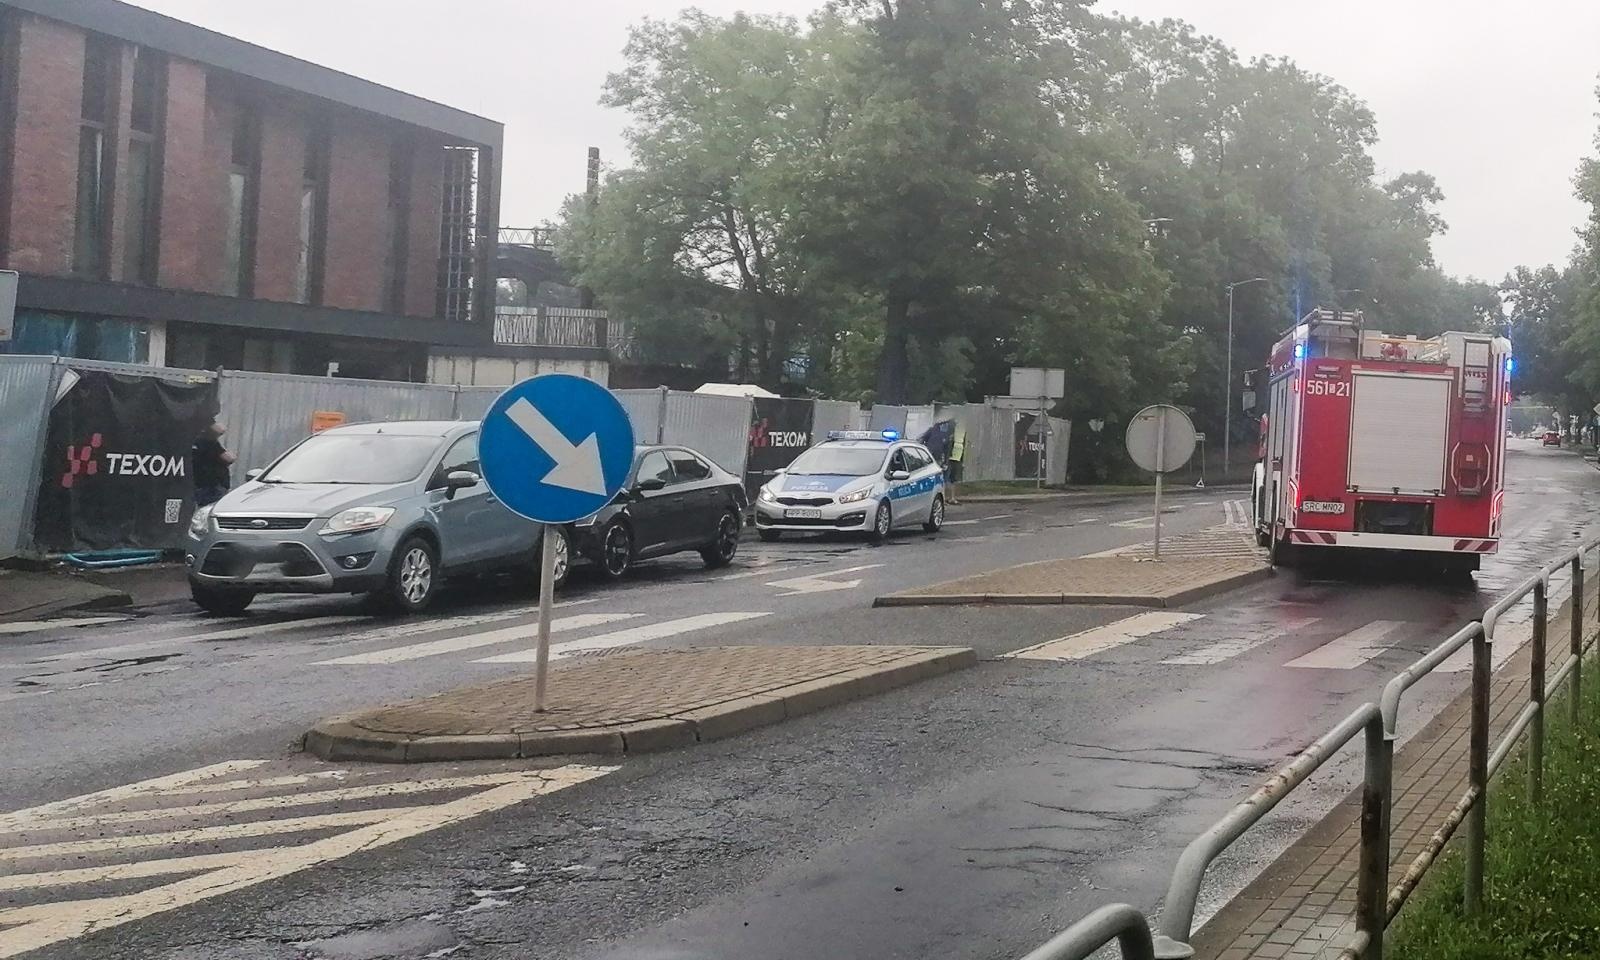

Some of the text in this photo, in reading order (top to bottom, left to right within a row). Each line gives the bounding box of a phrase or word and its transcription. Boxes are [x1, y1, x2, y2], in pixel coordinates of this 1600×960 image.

[768, 431, 807, 447] TEXOM
[106, 453, 185, 476] TEXOM
[1304, 502, 1320, 511] SRC
